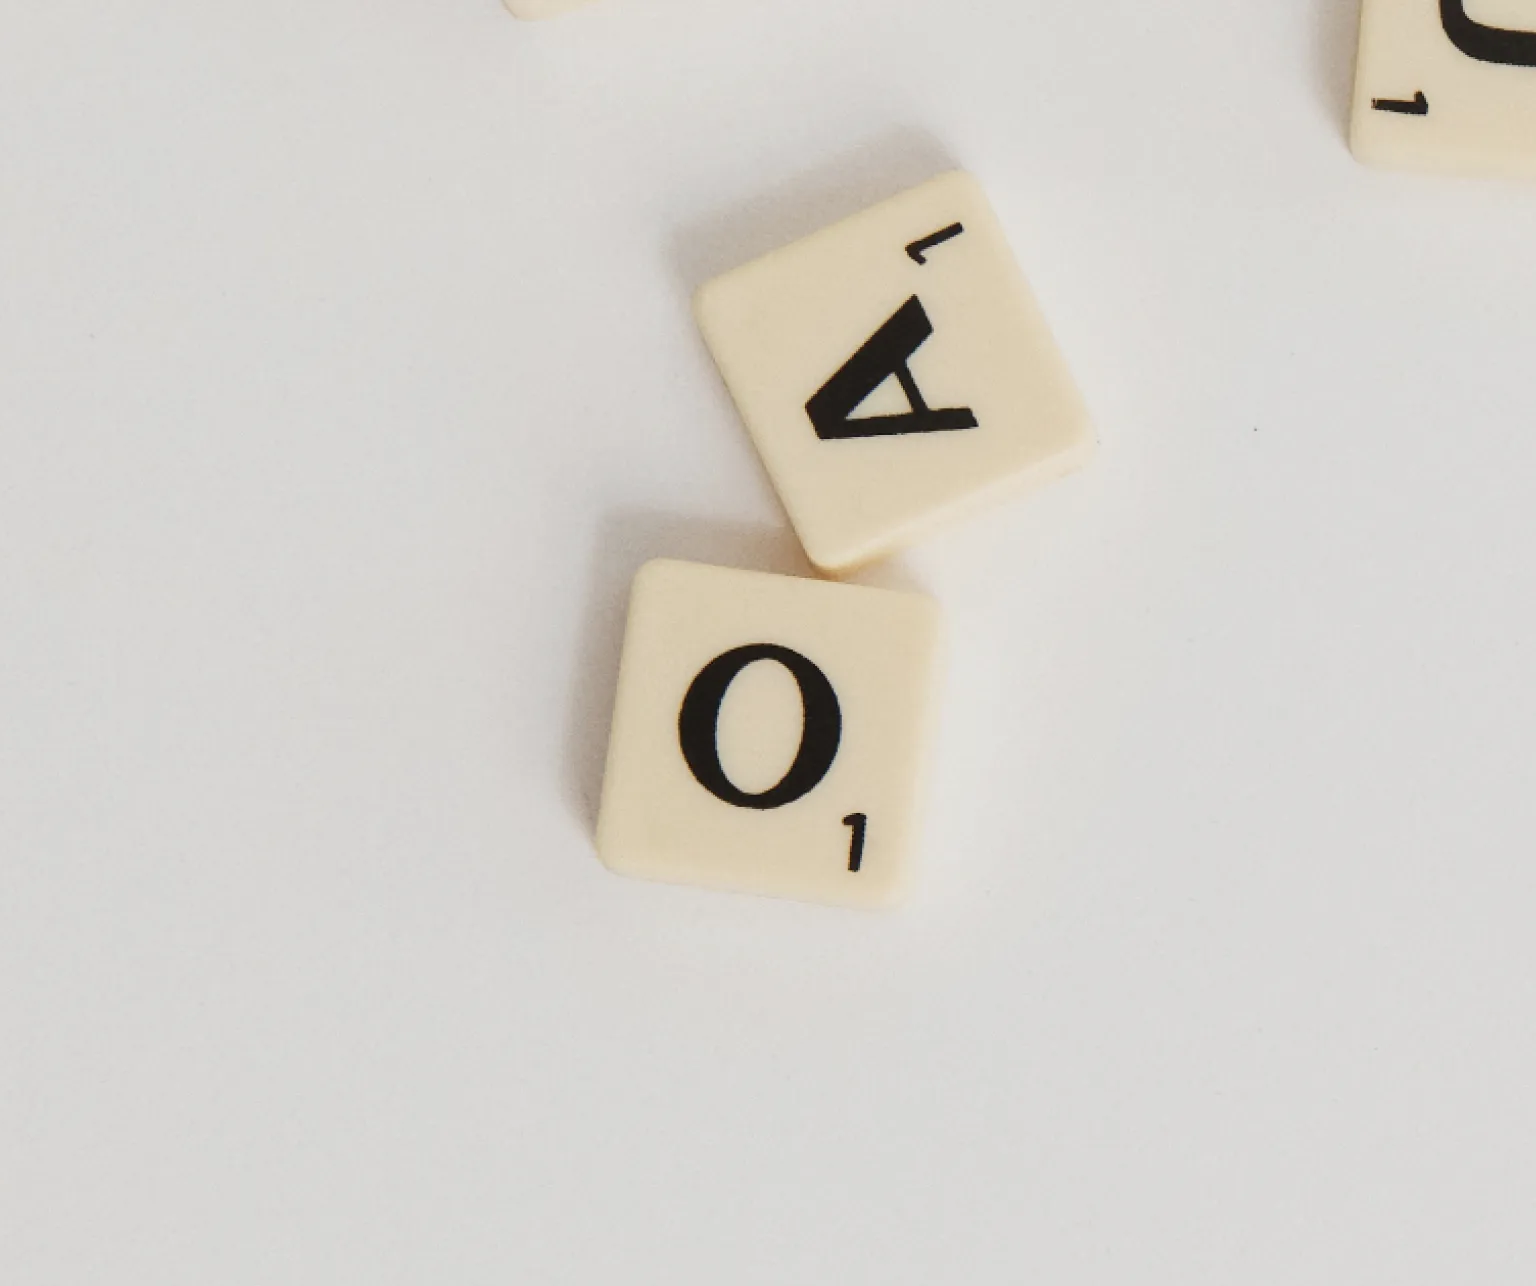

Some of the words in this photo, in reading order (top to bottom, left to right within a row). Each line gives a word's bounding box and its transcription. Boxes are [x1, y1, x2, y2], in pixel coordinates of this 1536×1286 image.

[1371, 90, 1429, 116] 1
[804, 293, 979, 440] A
[904, 222, 964, 266] 1
[677, 642, 843, 810] O
[841, 812, 867, 873] 1
